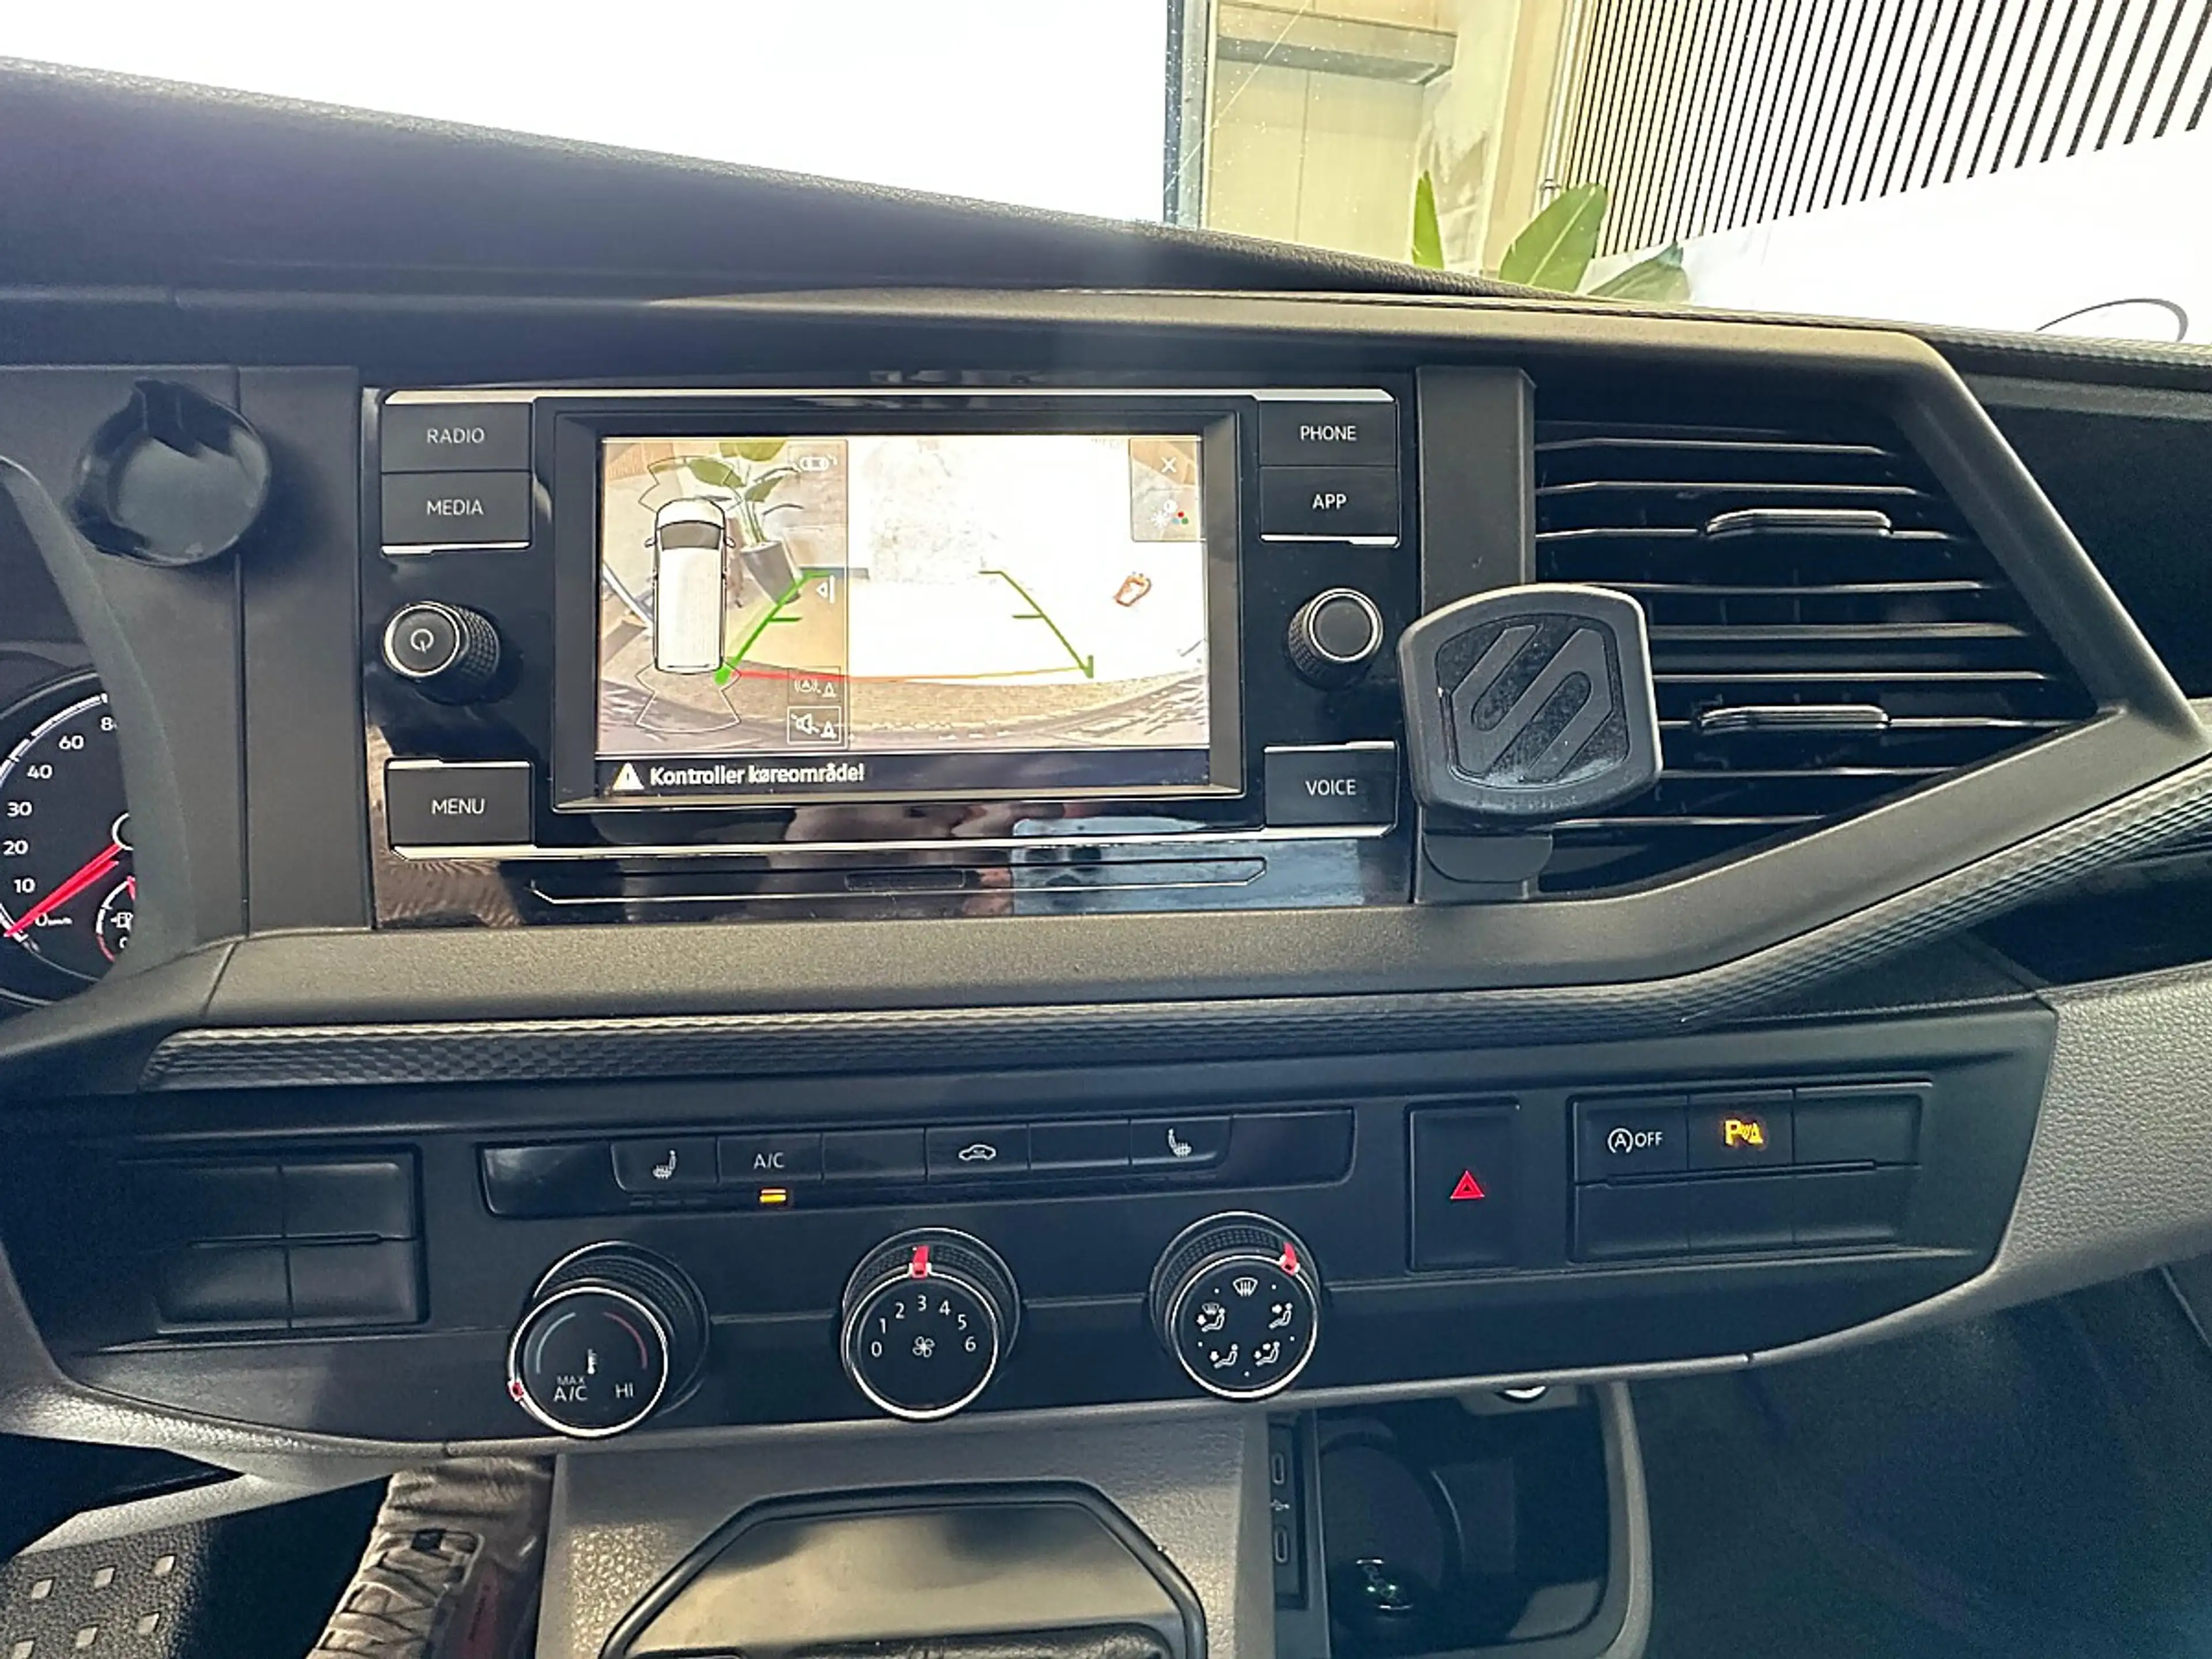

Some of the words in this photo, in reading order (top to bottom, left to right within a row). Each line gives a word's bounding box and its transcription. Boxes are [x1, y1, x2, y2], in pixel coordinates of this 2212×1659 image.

[426, 427, 485, 444] RADIO
[1300, 425, 1358, 441] PHONE
[426, 499, 484, 516] MEDIA
[1312, 493, 1347, 510] APP
[100, 717, 118, 731] 8
[58, 735, 85, 750] 60
[26, 764, 53, 779] 40
[650, 766, 746, 786] Kontroller
[748, 763, 865, 783] køreområde!
[1305, 779, 1357, 796] VOICE
[6, 801, 33, 817] 30
[431, 797, 486, 815] MENU
[3, 840, 29, 856] 20
[14, 878, 36, 893] 10
[1634, 1131, 1664, 1148] OFF
[753, 1152, 786, 1169] A/C
[894, 1302, 906, 1319] 2
[917, 1295, 927, 1312] 3
[938, 1300, 950, 1316] 4
[878, 1317, 887, 1334] 1
[957, 1314, 967, 1331] 5
[870, 1341, 882, 1358] 0
[964, 1336, 976, 1353] 6
[556, 1374, 586, 1385] MAX
[552, 1385, 588, 1403] A/C
[615, 1382, 634, 1399] HI
